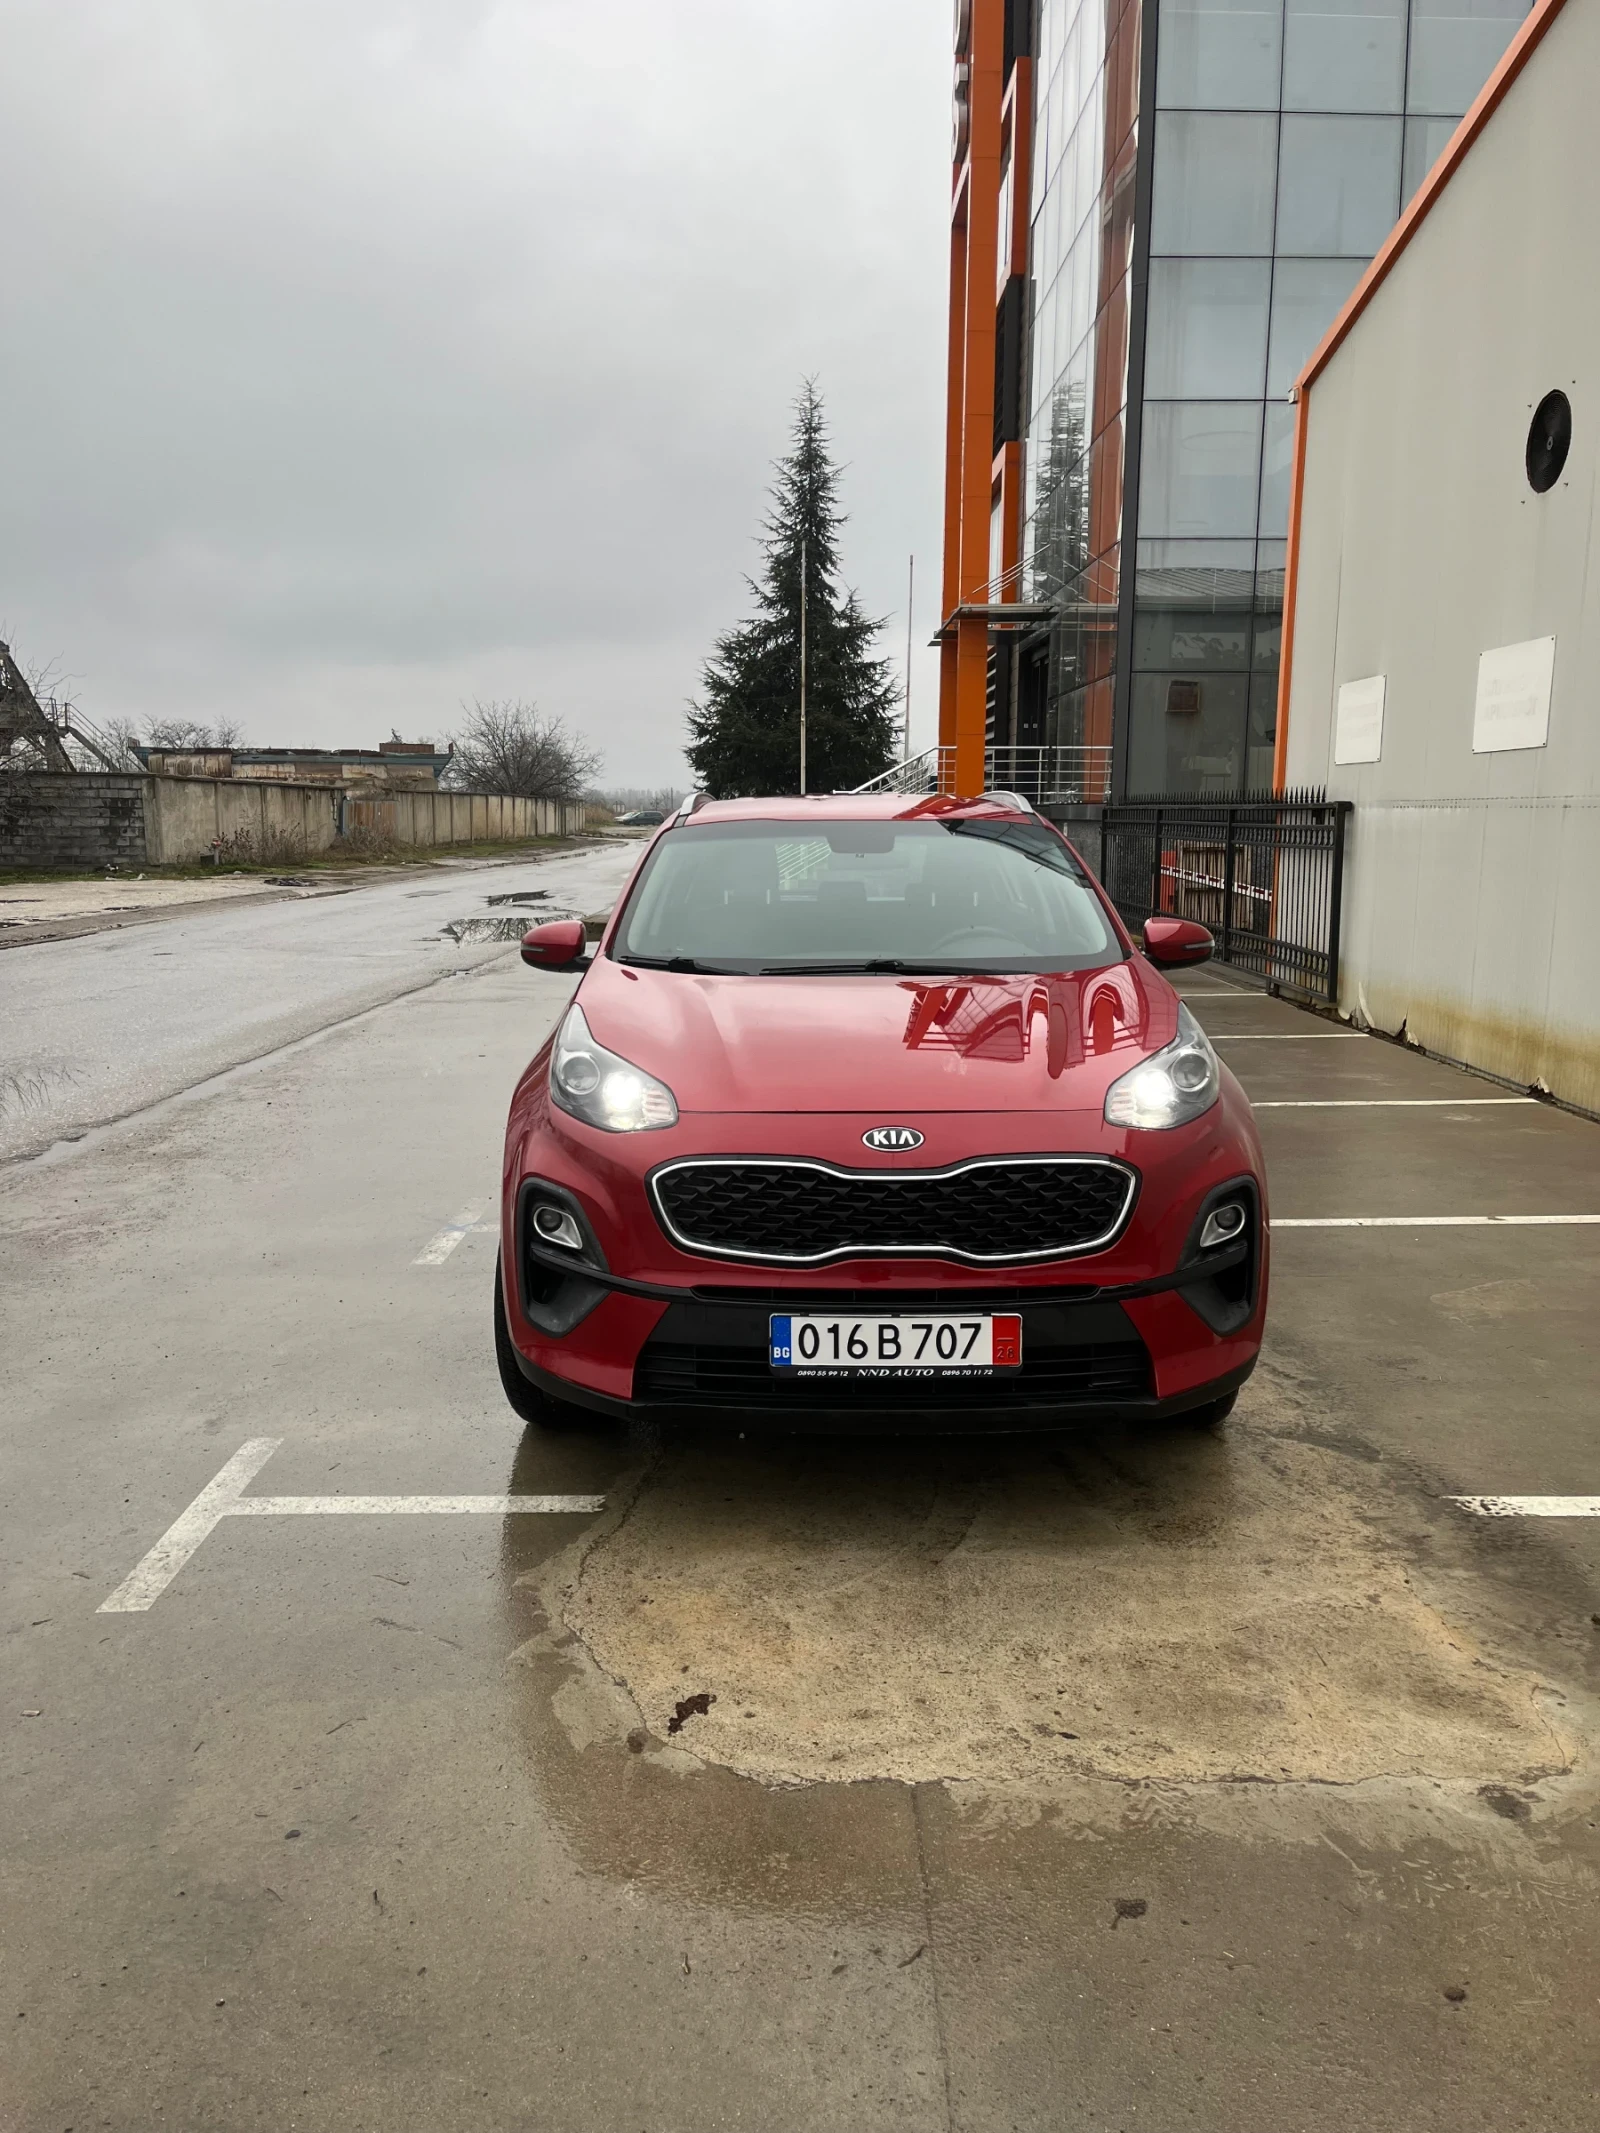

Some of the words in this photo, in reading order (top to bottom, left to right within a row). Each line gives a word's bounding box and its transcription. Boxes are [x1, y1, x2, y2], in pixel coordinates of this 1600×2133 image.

[872, 1130, 915, 1146] KIA
[798, 1323, 869, 1360] 016
[878, 1324, 901, 1360] B
[911, 1323, 982, 1360] 707
[773, 1347, 790, 1358] BG
[856, 1368, 890, 1377] NND
[892, 1368, 935, 1377] AUTO
